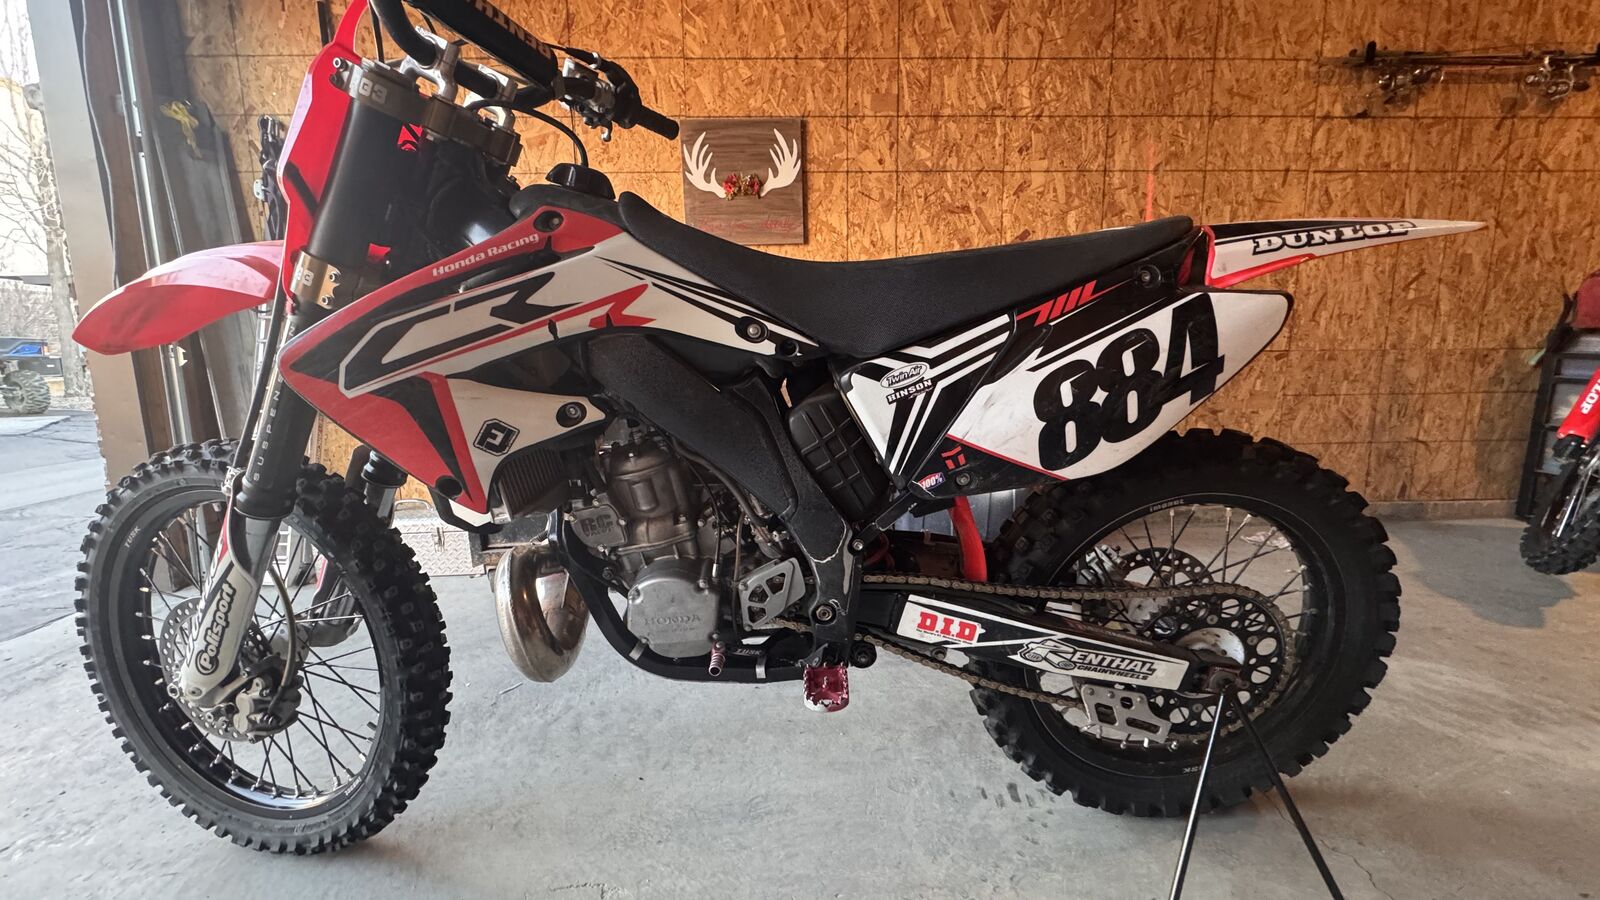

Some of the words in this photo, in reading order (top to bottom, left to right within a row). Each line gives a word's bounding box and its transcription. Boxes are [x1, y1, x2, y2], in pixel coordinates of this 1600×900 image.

[1252, 221, 1416, 255] DUNLOP
[432, 252, 486, 277] Honda
[487, 233, 539, 257] Racing
[886, 371, 909, 387] Twin
[908, 365, 923, 378] Air
[887, 379, 933, 403] HINSON
[1033, 292, 1225, 471] 884
[920, 473, 943, 489] 100%
[197, 579, 237, 674] Polisport
[917, 611, 977, 641] D.I.D
[1077, 664, 1149, 681] CHAINWHEELS
